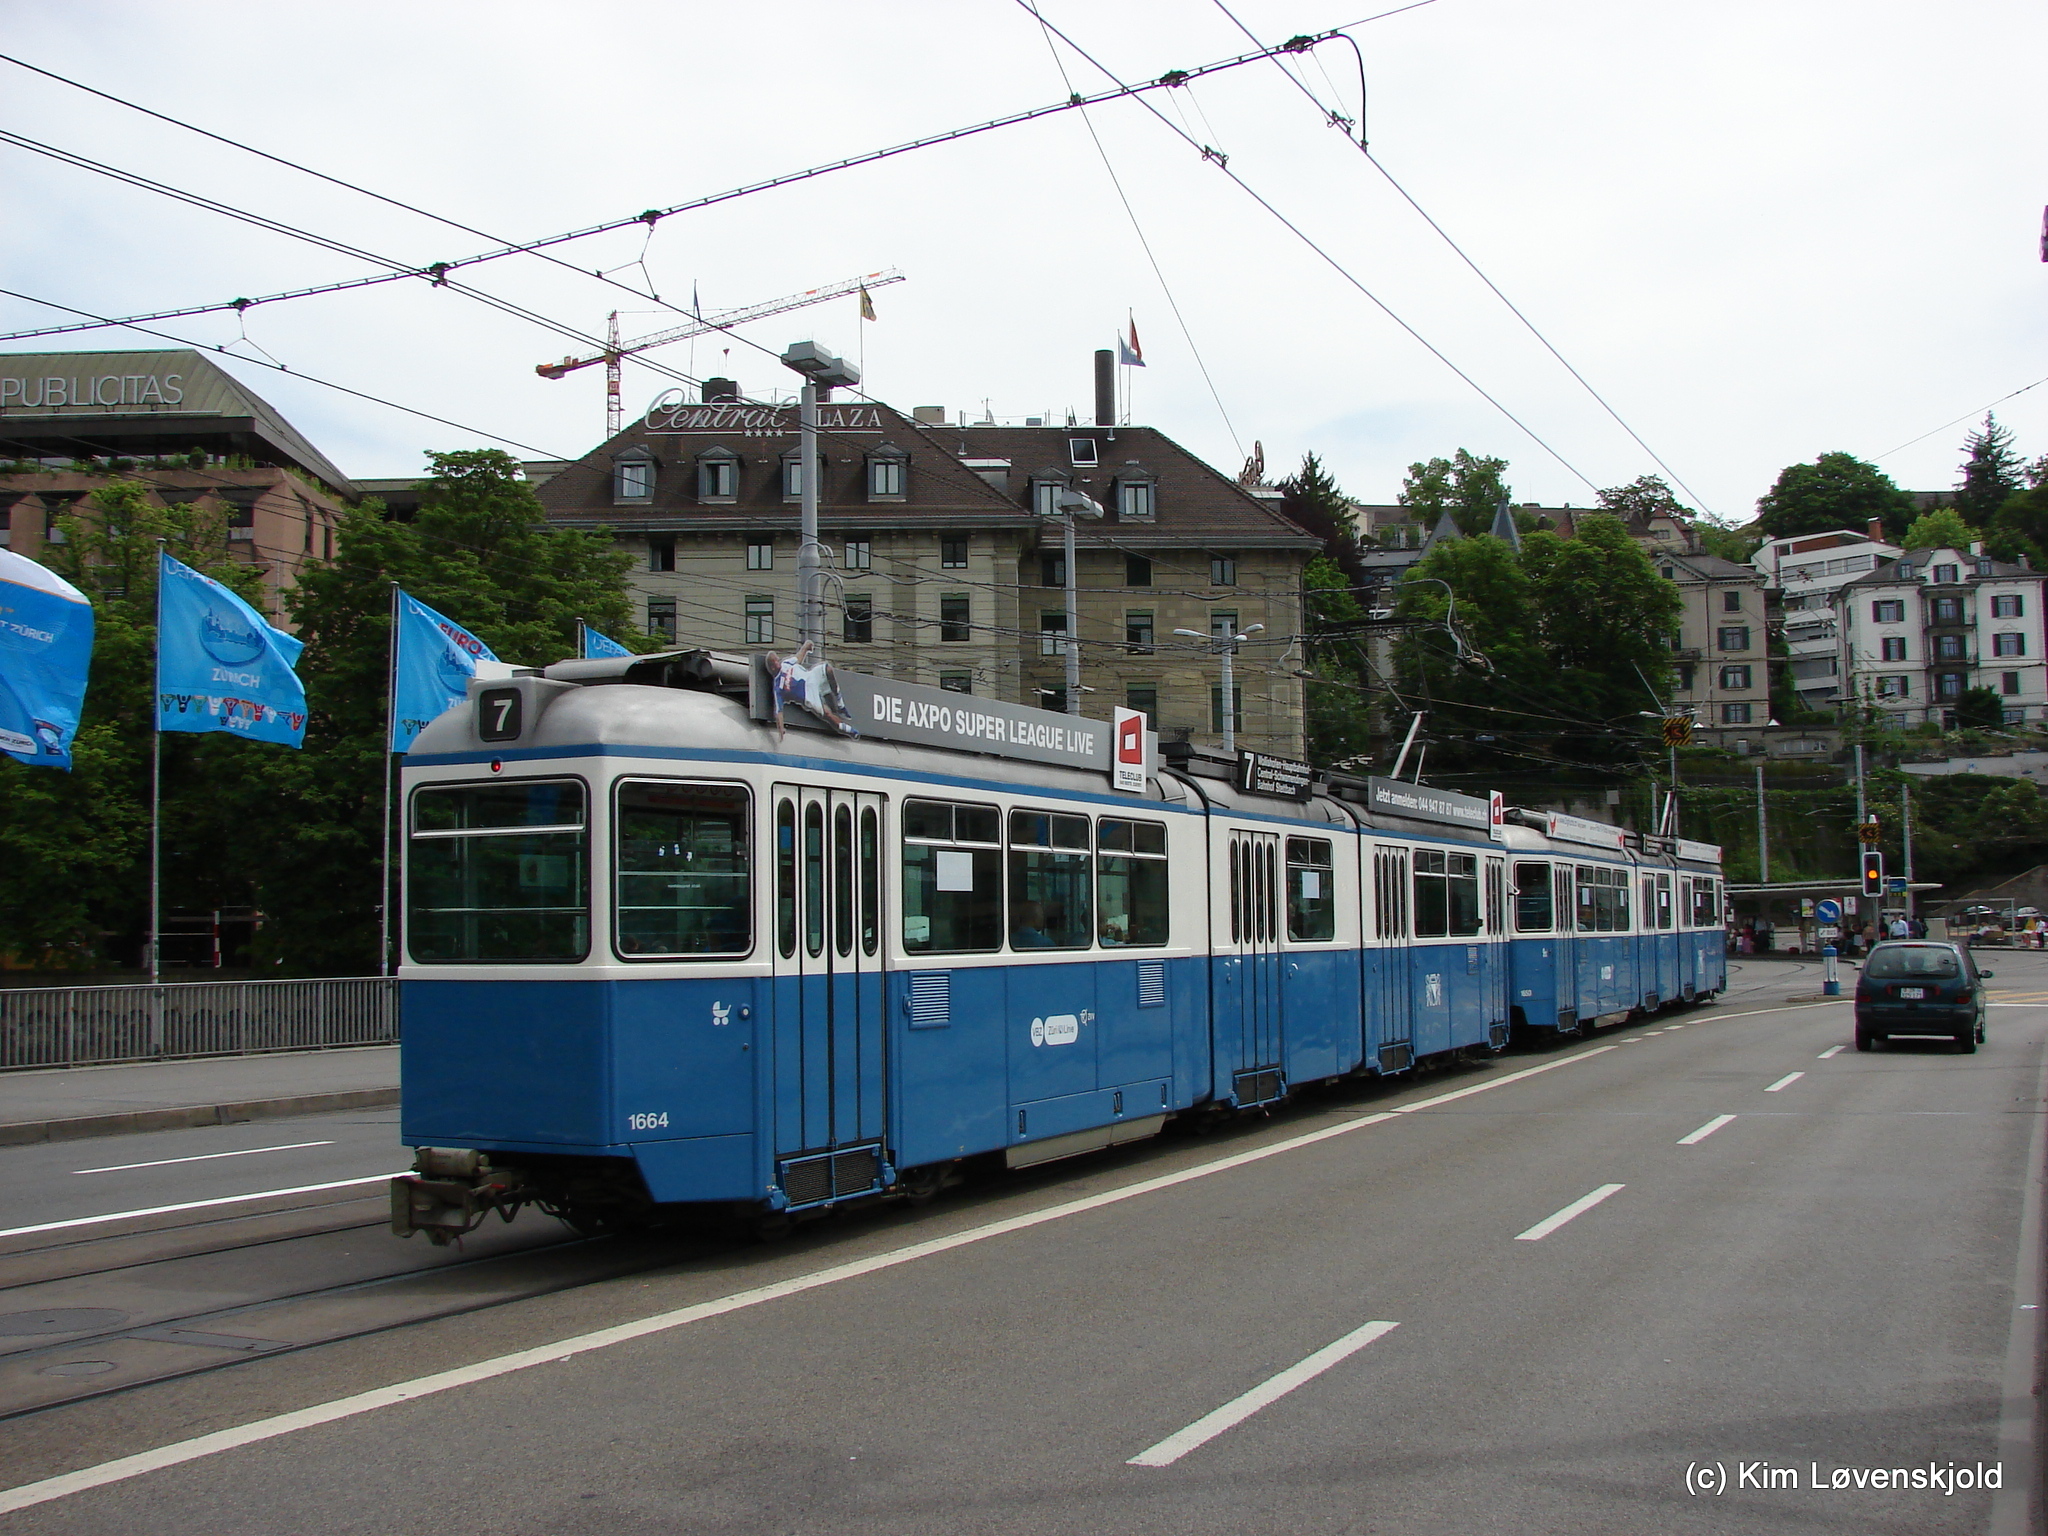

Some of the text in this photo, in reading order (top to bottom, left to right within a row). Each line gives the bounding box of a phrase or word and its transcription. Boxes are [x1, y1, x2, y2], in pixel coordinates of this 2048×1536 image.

[1, 374, 184, 408] PUBLICITAS
[645, 387, 882, 430] Central LAZA
[10, 623, 54, 643] ZÜRICH
[493, 699, 513, 731] 7
[873, 694, 1094, 755] DIE AXPO SUPER LEAGUE LIVE
[1244, 751, 1255, 789] 7
[1375, 786, 1391, 804] Jetzt
[1418, 796, 1429, 812] 044
[1033, 1026, 1043, 1036] VBZ
[628, 1111, 669, 1130] 1664
